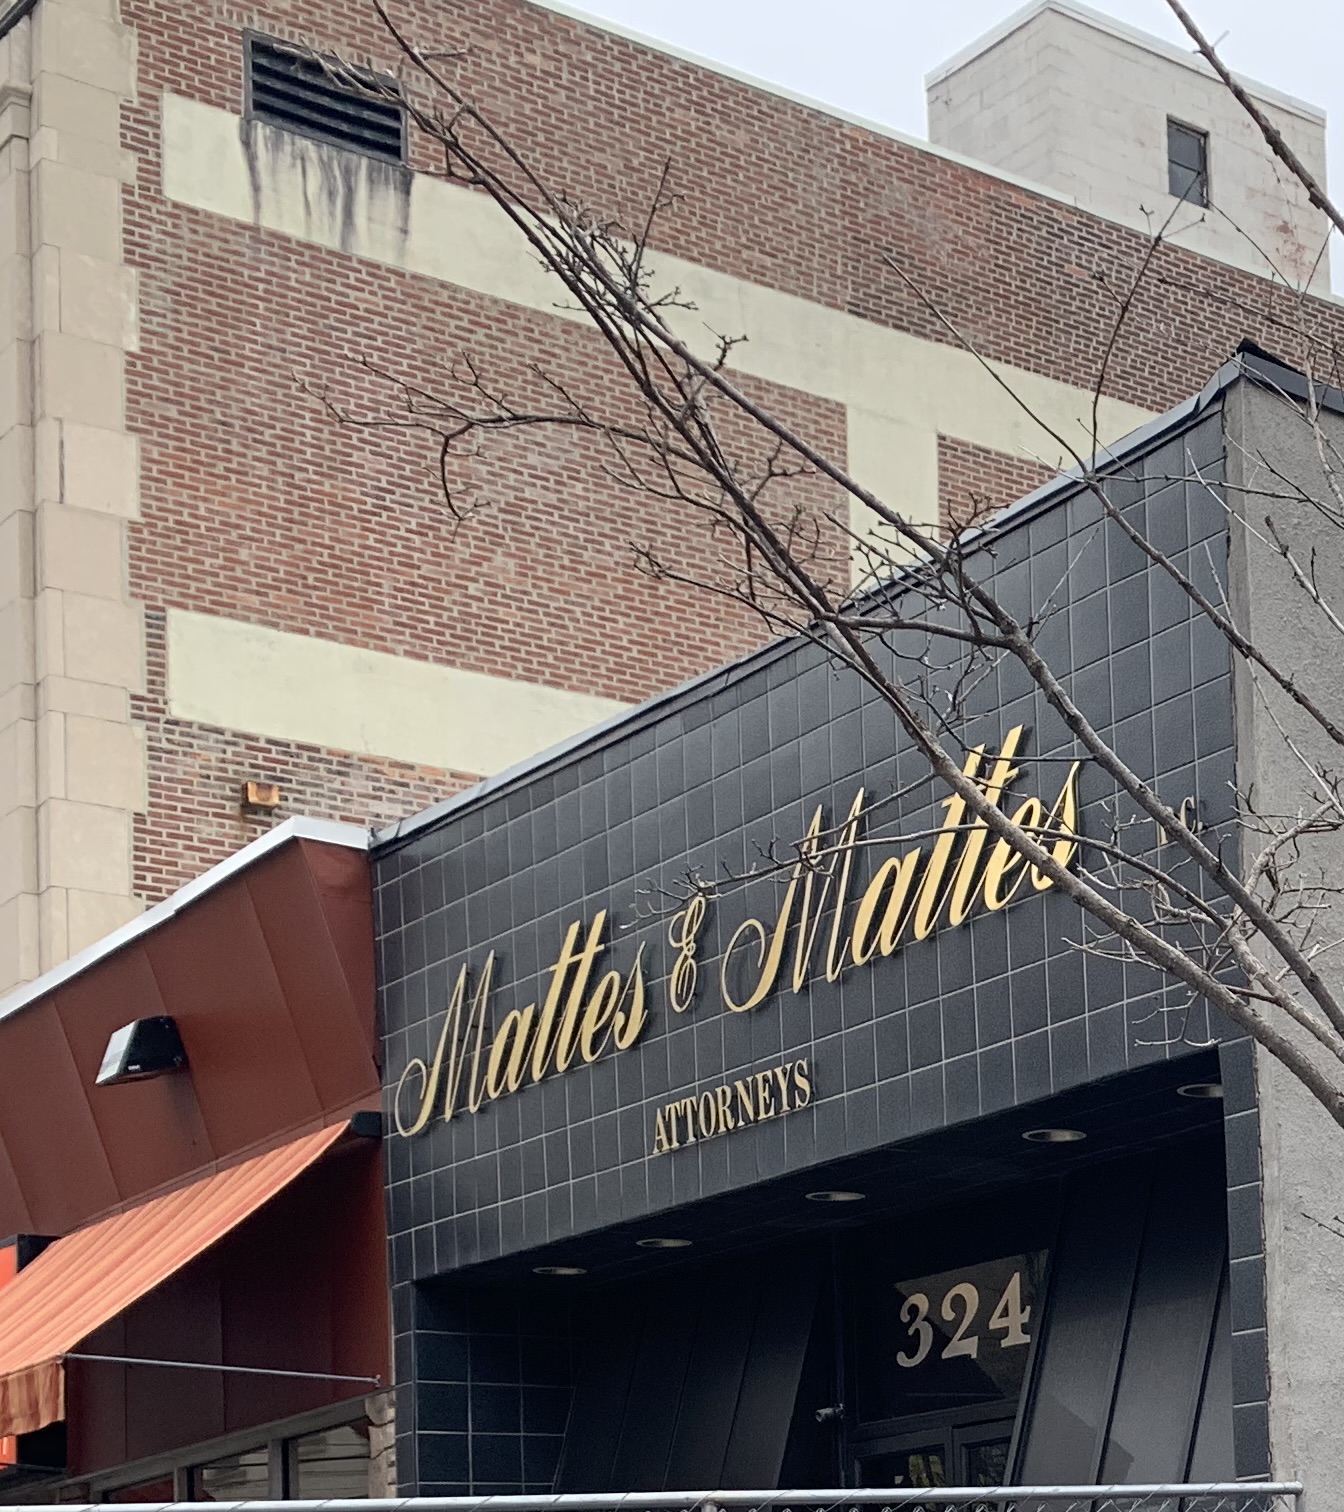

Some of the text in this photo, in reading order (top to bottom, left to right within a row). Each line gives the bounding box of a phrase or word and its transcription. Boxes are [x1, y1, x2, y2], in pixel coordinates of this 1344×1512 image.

[395, 907, 646, 1139] Mattes
[670, 896, 707, 1013] &
[721, 725, 1083, 1014] Mattes
[652, 1058, 812, 1156] ATTORNEYS
[896, 1271, 1032, 1368] 324
